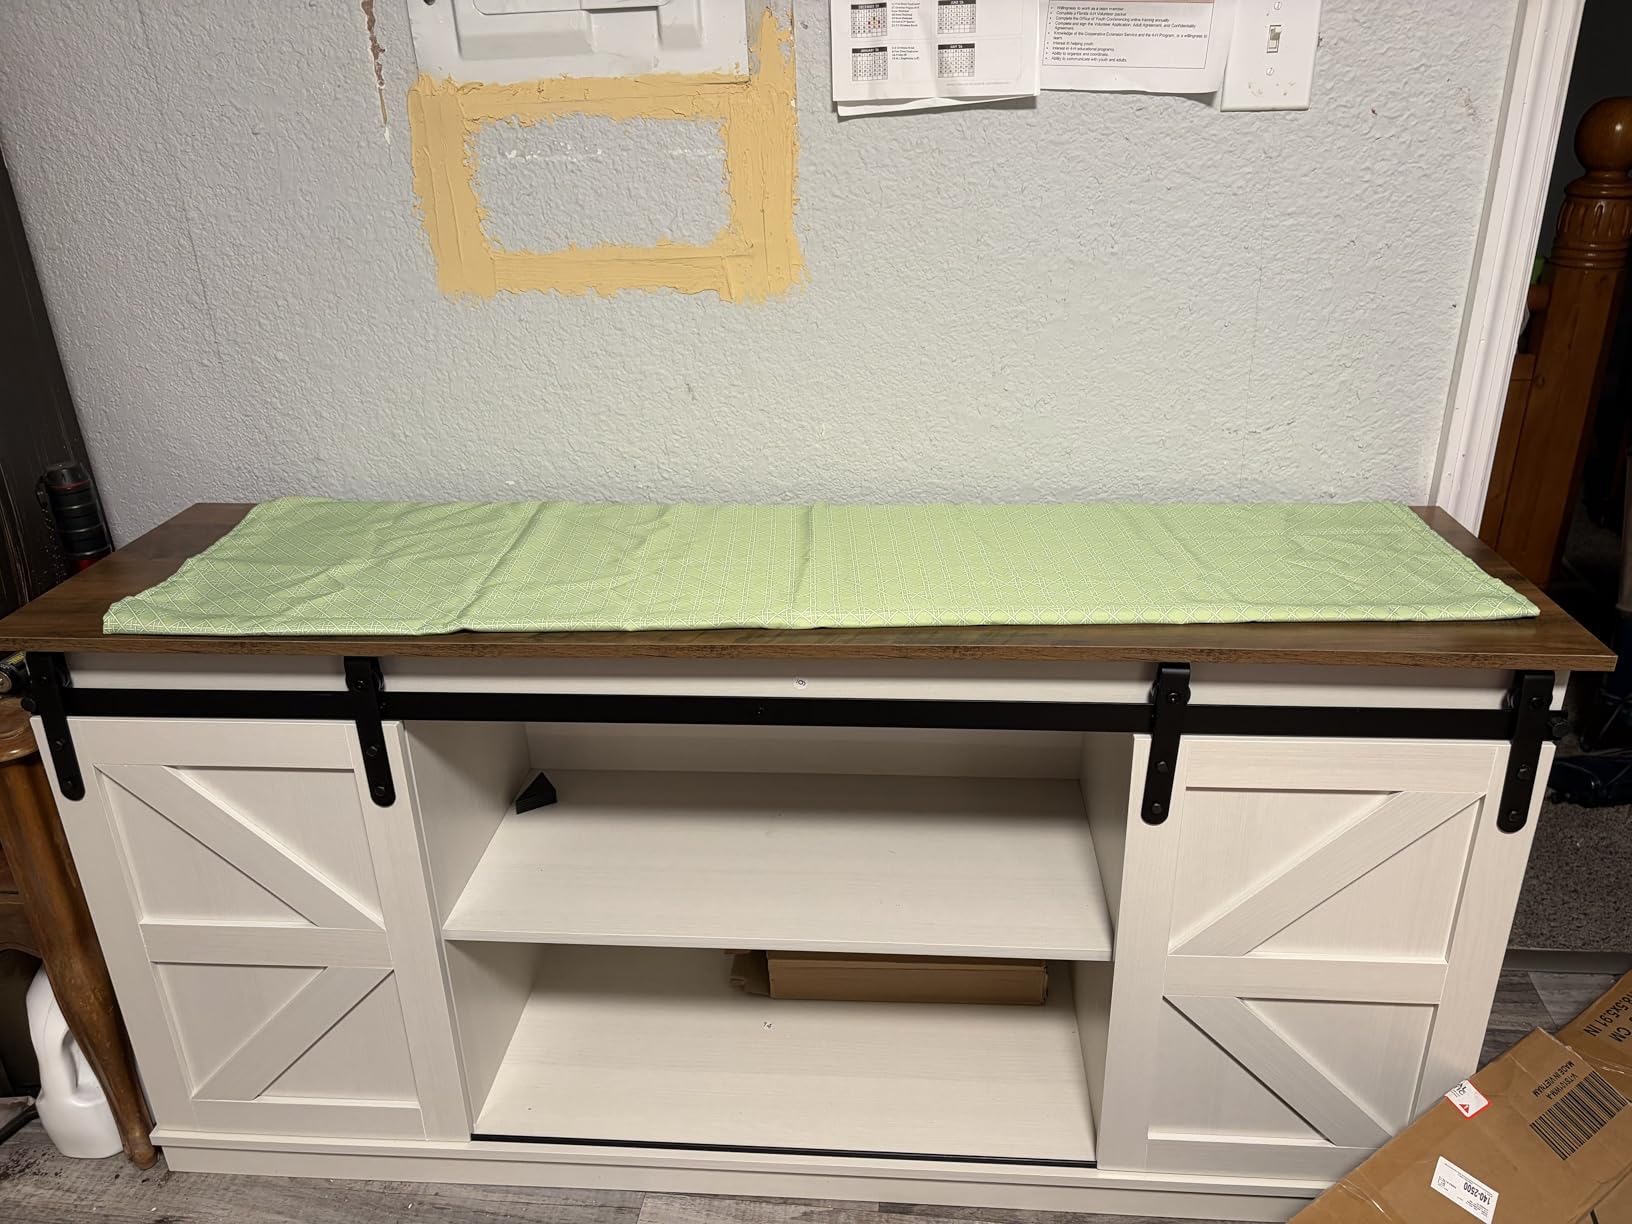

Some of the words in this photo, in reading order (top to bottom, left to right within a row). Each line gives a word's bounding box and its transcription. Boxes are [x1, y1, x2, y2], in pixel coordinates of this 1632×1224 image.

[1584, 1024, 1602, 1036] IN
[1608, 1026, 1631, 1042] CM
[1558, 1060, 1575, 1075] MADE
[1532, 1076, 1556, 1097] VIETNAM
[1463, 1181, 1491, 1206] 140-2500
